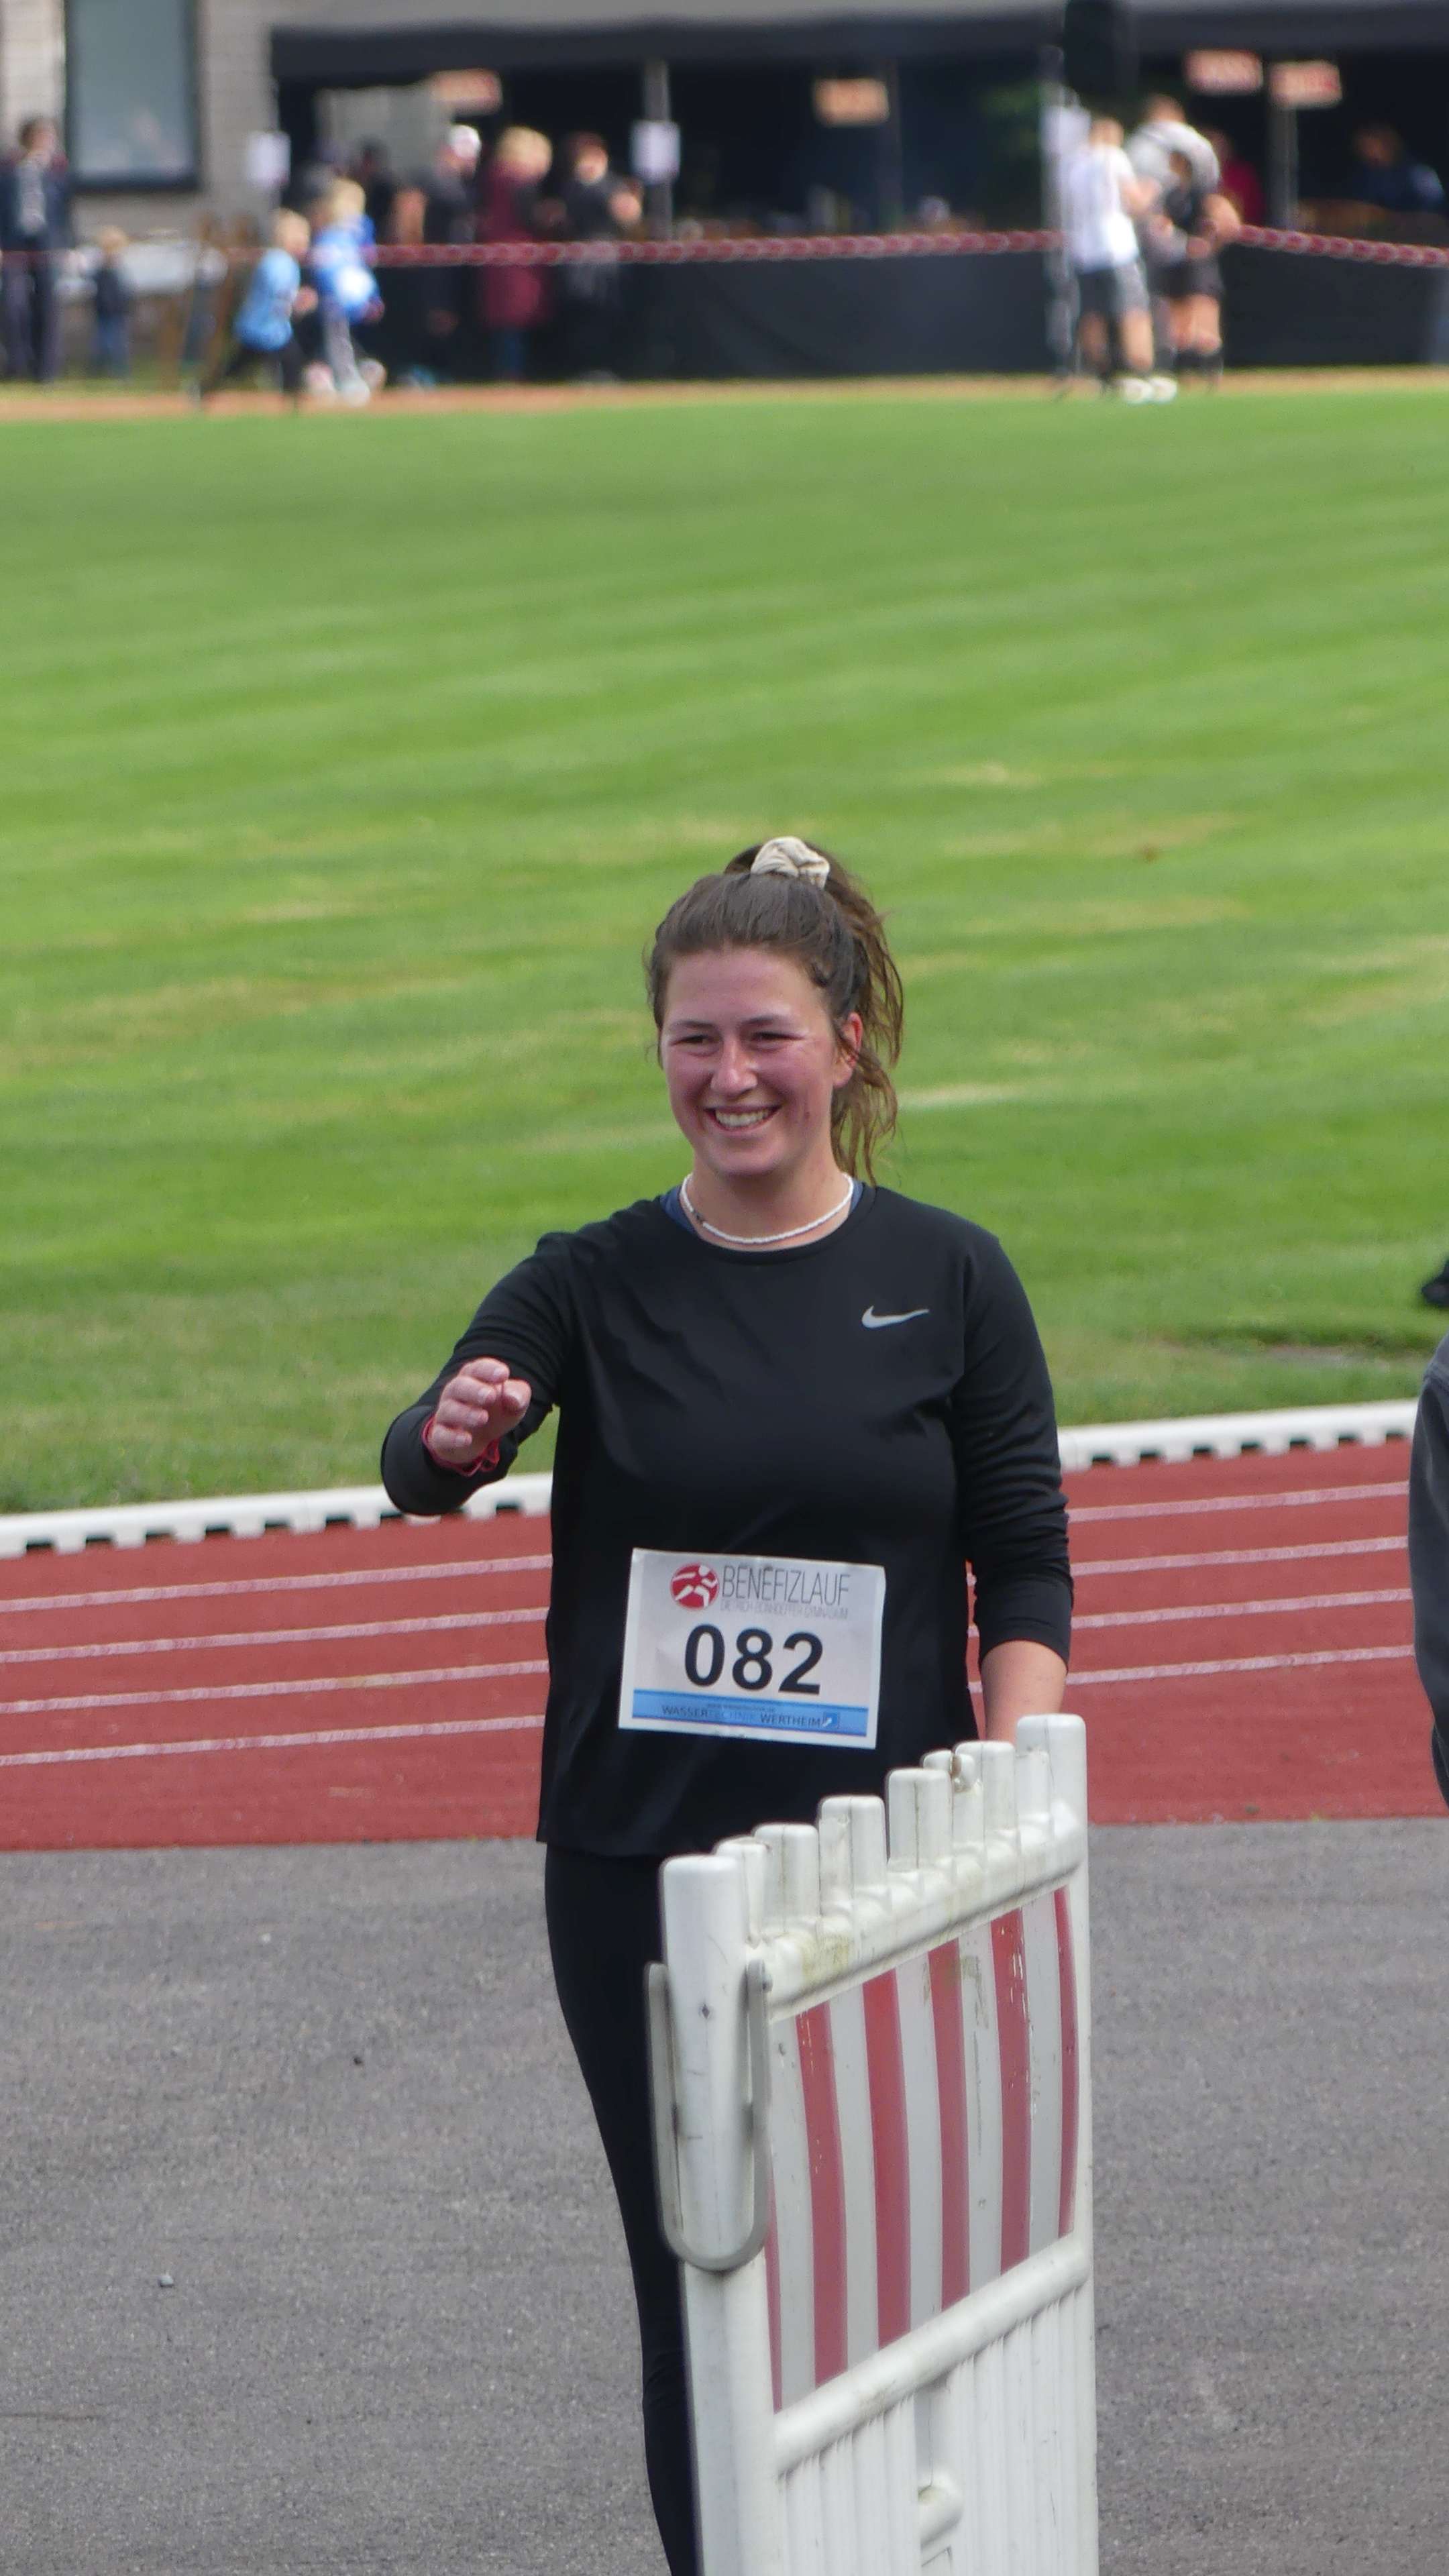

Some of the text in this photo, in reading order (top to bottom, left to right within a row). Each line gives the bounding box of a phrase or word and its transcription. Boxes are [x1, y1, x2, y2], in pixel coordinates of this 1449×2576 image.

[722, 1565, 850, 1605] BENEFIZLAUF
[684, 1623, 824, 1695] 082
[760, 1714, 821, 1727] WERTHEIM
